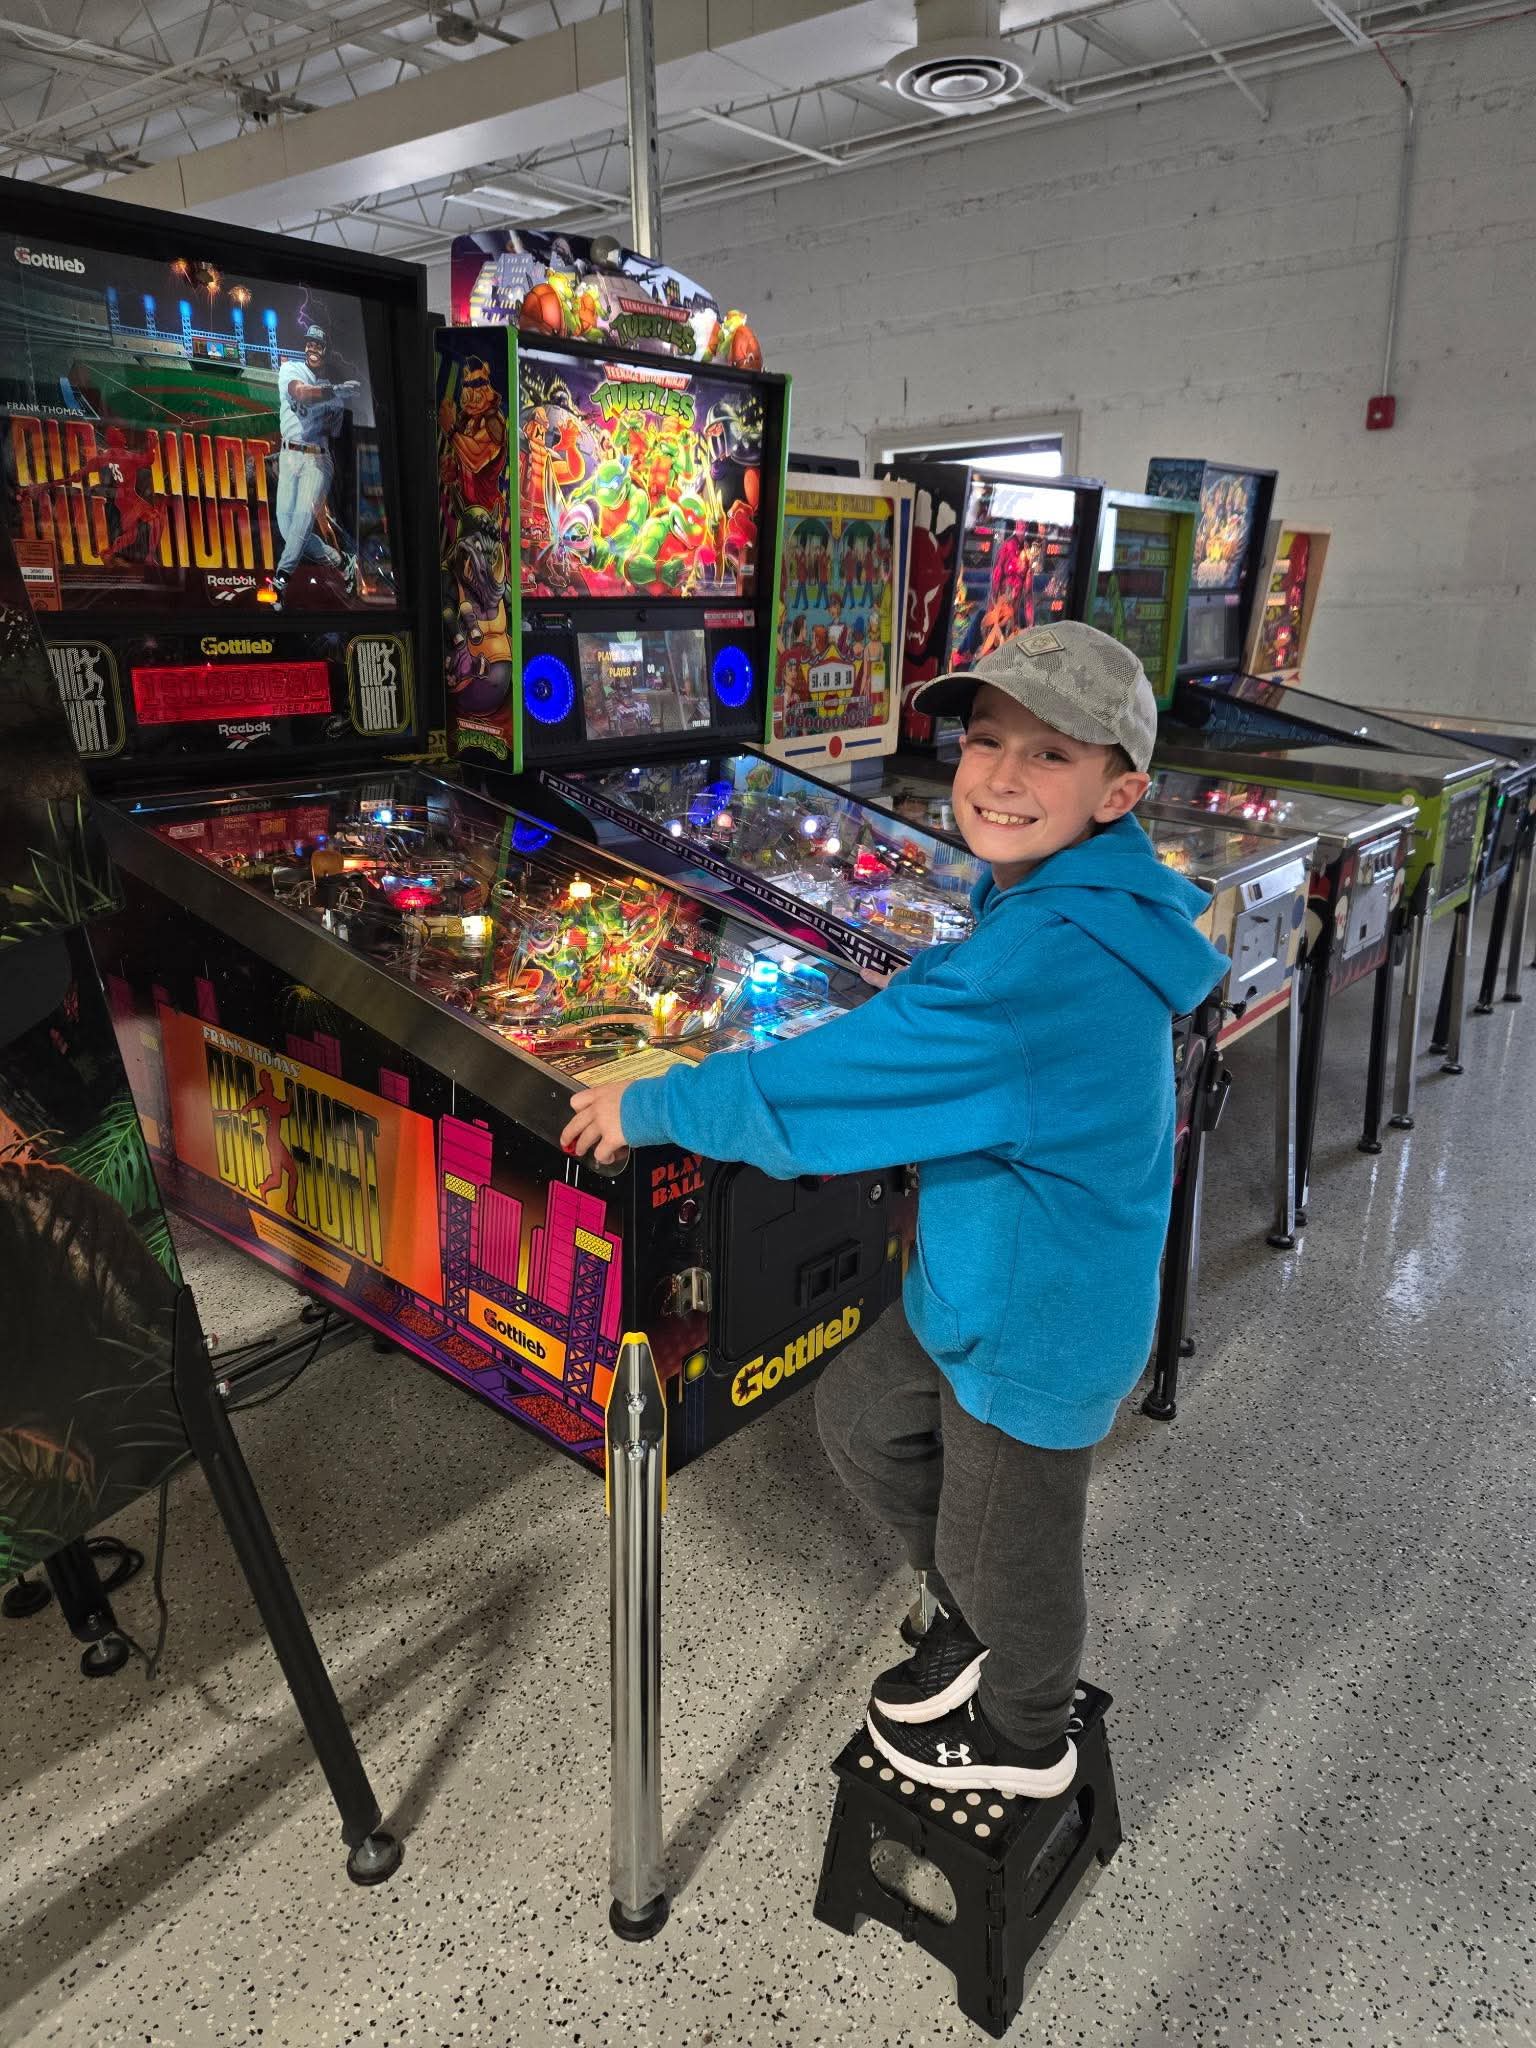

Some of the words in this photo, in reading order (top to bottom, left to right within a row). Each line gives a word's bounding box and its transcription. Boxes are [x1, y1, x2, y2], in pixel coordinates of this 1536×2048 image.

[14, 246, 86, 274] Gottlieb
[608, 312, 697, 356] TURTLES
[6, 401, 41, 413] FRANK
[42, 405, 85, 417] THOMAS
[589, 381, 697, 430] TURTLES
[108, 462, 124, 483] 35
[146, 428, 275, 570] HURT
[207, 575, 257, 587] Reebok
[200, 636, 273, 656] Gottlieb
[609, 666, 631, 678] PLAYER
[360, 685, 398, 731] HURT
[219, 721, 272, 737] Reebok
[203, 1026, 243, 1052] FRANK
[247, 1044, 300, 1079] THOMAS
[283, 1077, 384, 1267] HURT
[652, 1152, 704, 1188] PLAY
[653, 1172, 705, 1209] BALL
[483, 1308, 547, 1360] Gottlieb
[731, 1306, 861, 1407] Gottlieb
